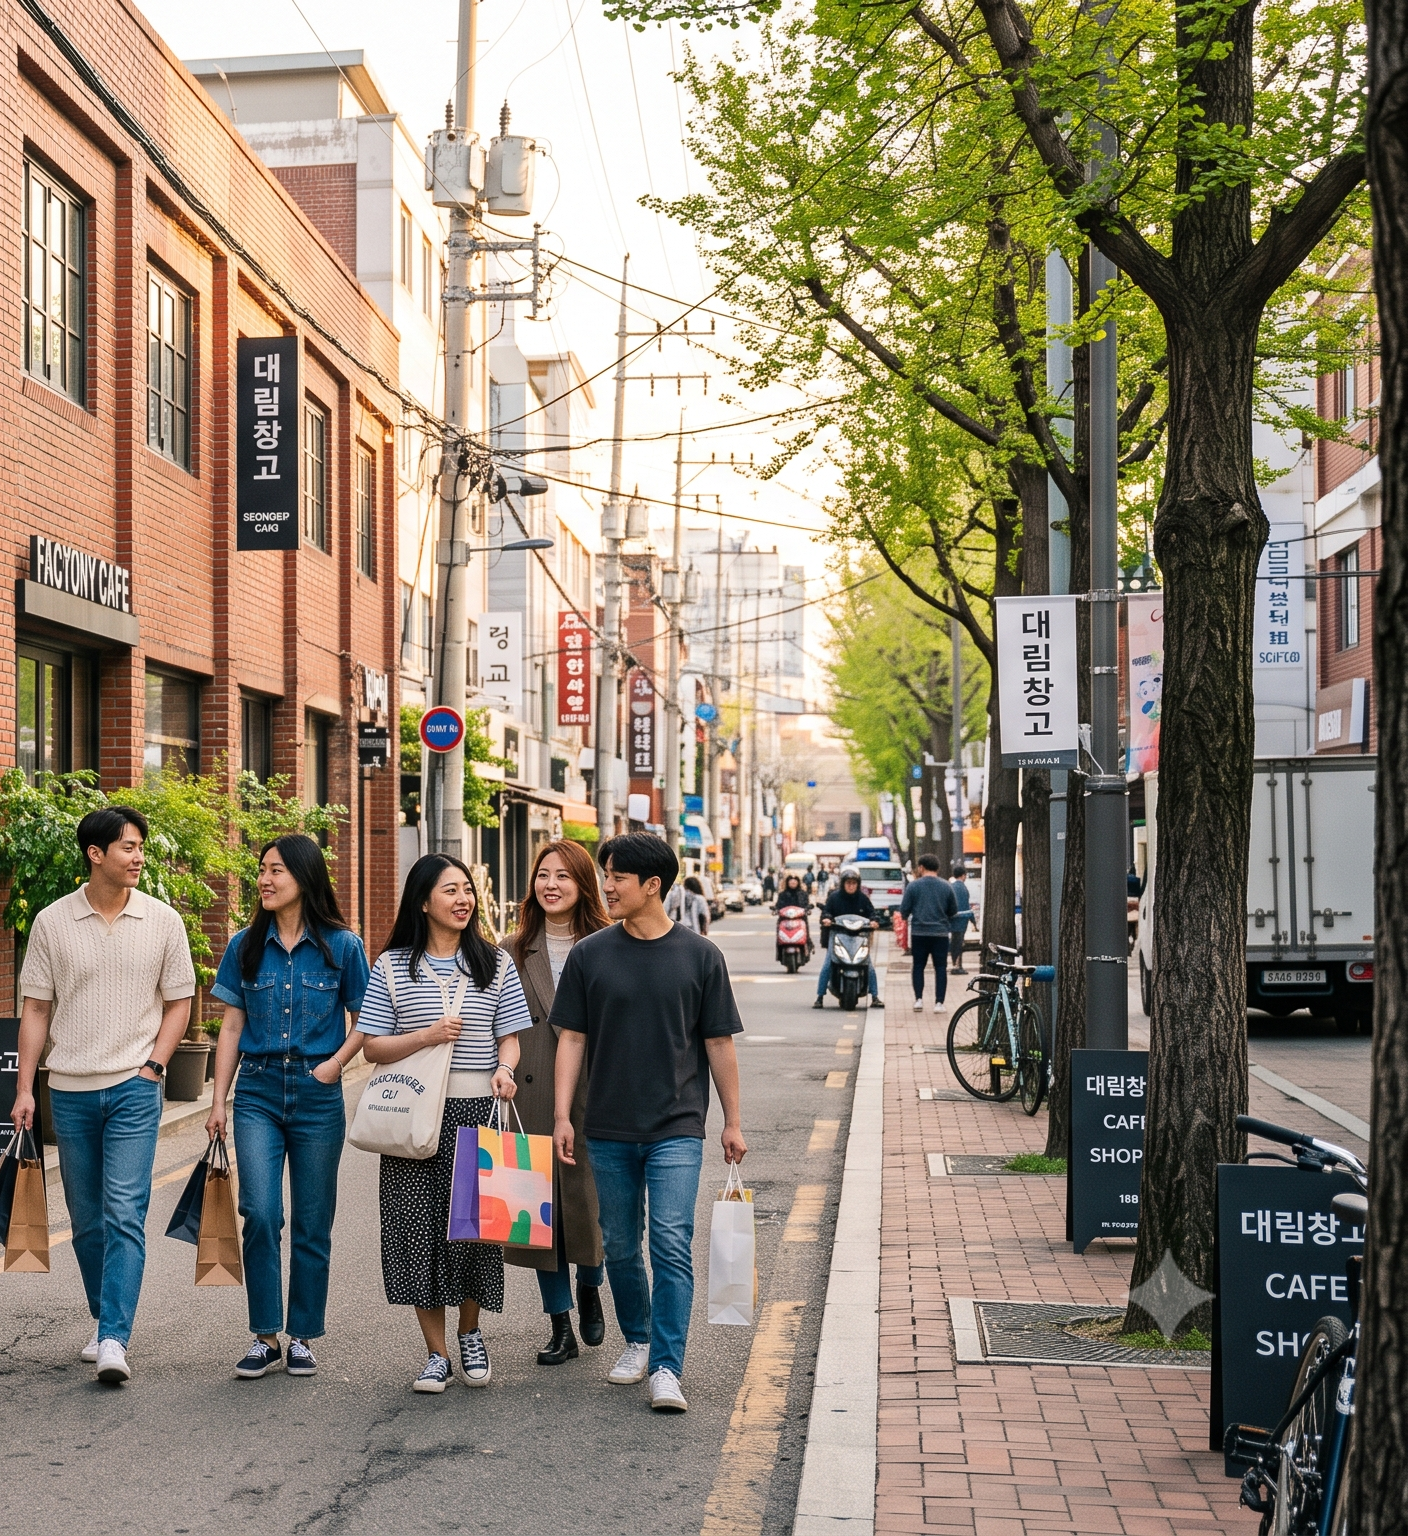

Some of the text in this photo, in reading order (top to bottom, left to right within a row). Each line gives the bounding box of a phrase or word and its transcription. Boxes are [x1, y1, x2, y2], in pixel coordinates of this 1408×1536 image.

[252, 353, 282, 481] 대림창고
[98, 559, 130, 613] CAFE
[1022, 610, 1054, 736] 대림창고
[1086, 1075, 1147, 1097] 대림창
[1090, 1147, 1143, 1164] SHOP
[1265, 1272, 1349, 1302] CAFE
[1255, 1330, 1311, 1357] SH
